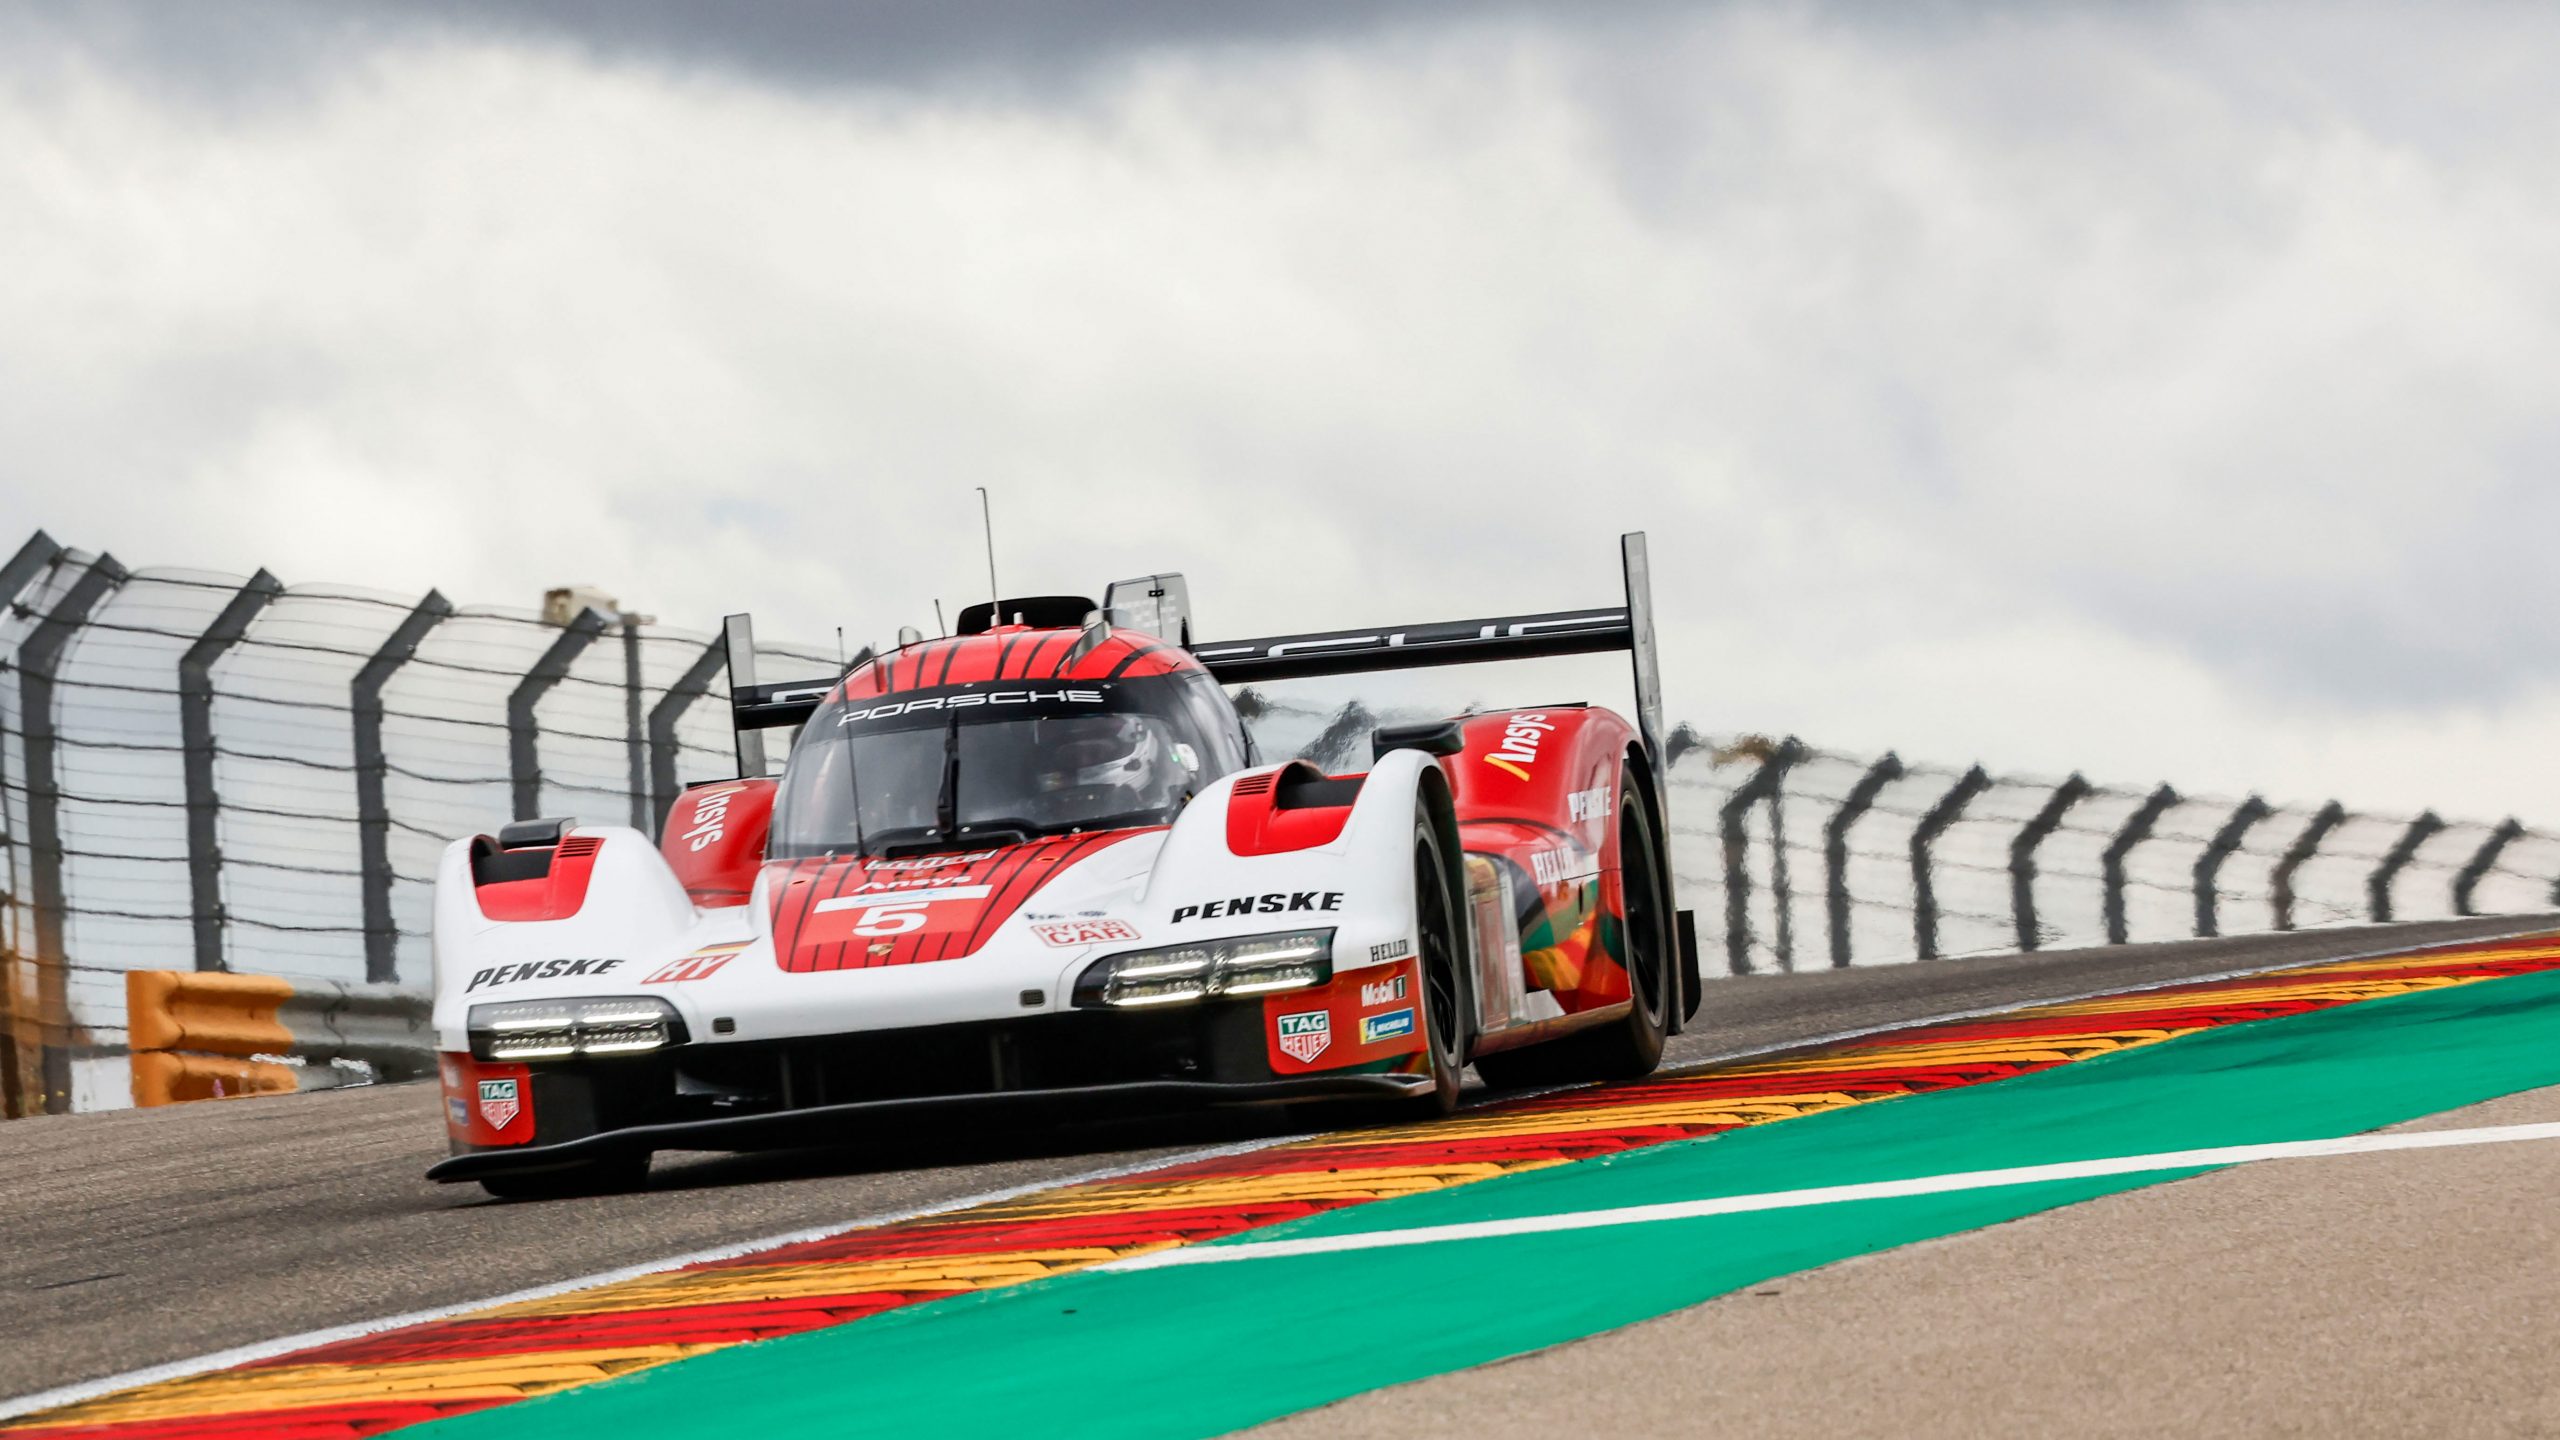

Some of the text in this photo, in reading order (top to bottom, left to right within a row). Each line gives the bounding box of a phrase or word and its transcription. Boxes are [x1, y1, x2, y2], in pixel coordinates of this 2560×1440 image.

[837, 689, 1104, 727] PORSCHE
[1484, 714, 1555, 782] Ansys
[853, 875, 972, 893] Ansys
[853, 902, 929, 936] 5
[1171, 892, 1345, 924] PENSKE
[1048, 928, 1132, 944] CAR
[465, 959, 625, 993] PENSKE
[1282, 1014, 1325, 1033] TAG
[480, 1082, 514, 1099] TAG
